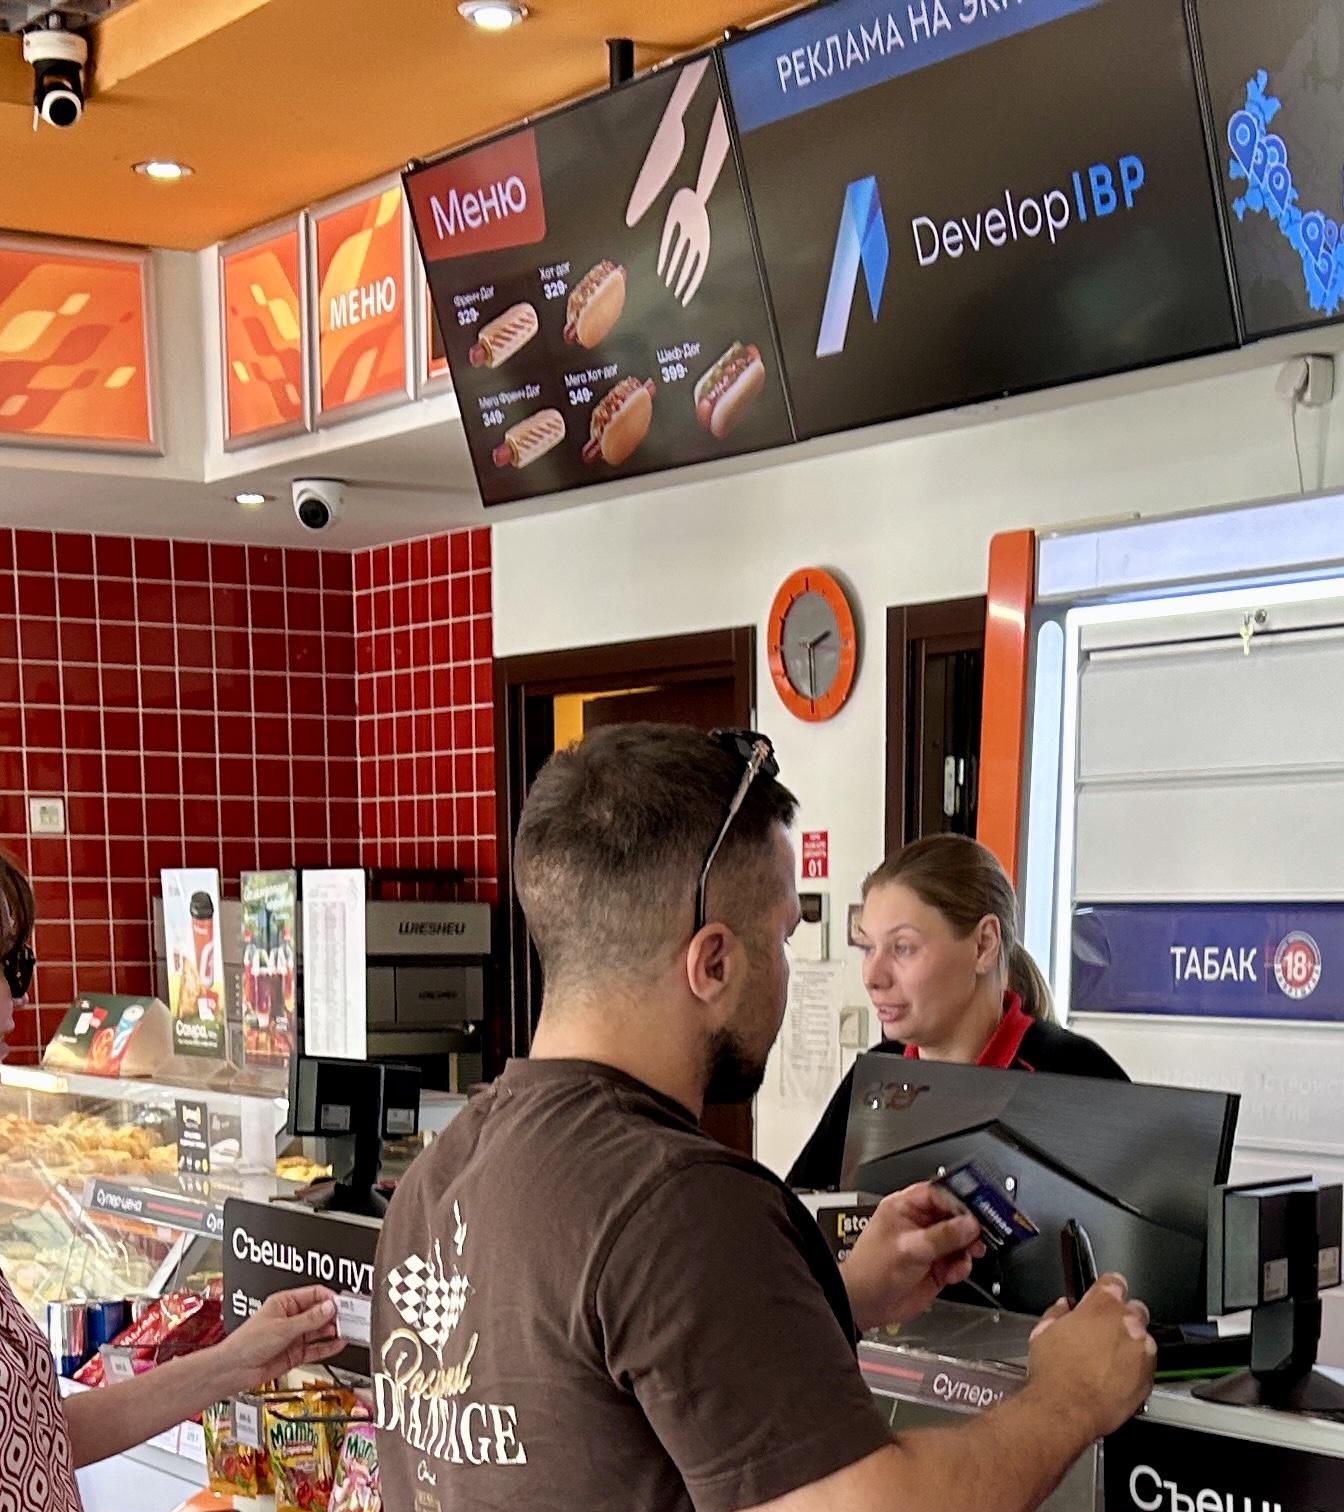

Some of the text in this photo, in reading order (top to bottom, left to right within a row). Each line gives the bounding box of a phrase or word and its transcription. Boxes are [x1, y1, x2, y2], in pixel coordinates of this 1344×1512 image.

[776, 13, 905, 93] РЕКЛАМА
[908, 2, 952, 44] НА
[430, 175, 527, 240] Меню
[329, 276, 397, 331] МЕНЮ
[807, 859, 823, 877] 01
[1170, 946, 1257, 983] ТАБАК
[1283, 950, 1314, 982] 18+
[842, 1217, 872, 1233] sto
[232, 1227, 376, 1293] Съешь по пут
[270, 1421, 320, 1450] Mambo
